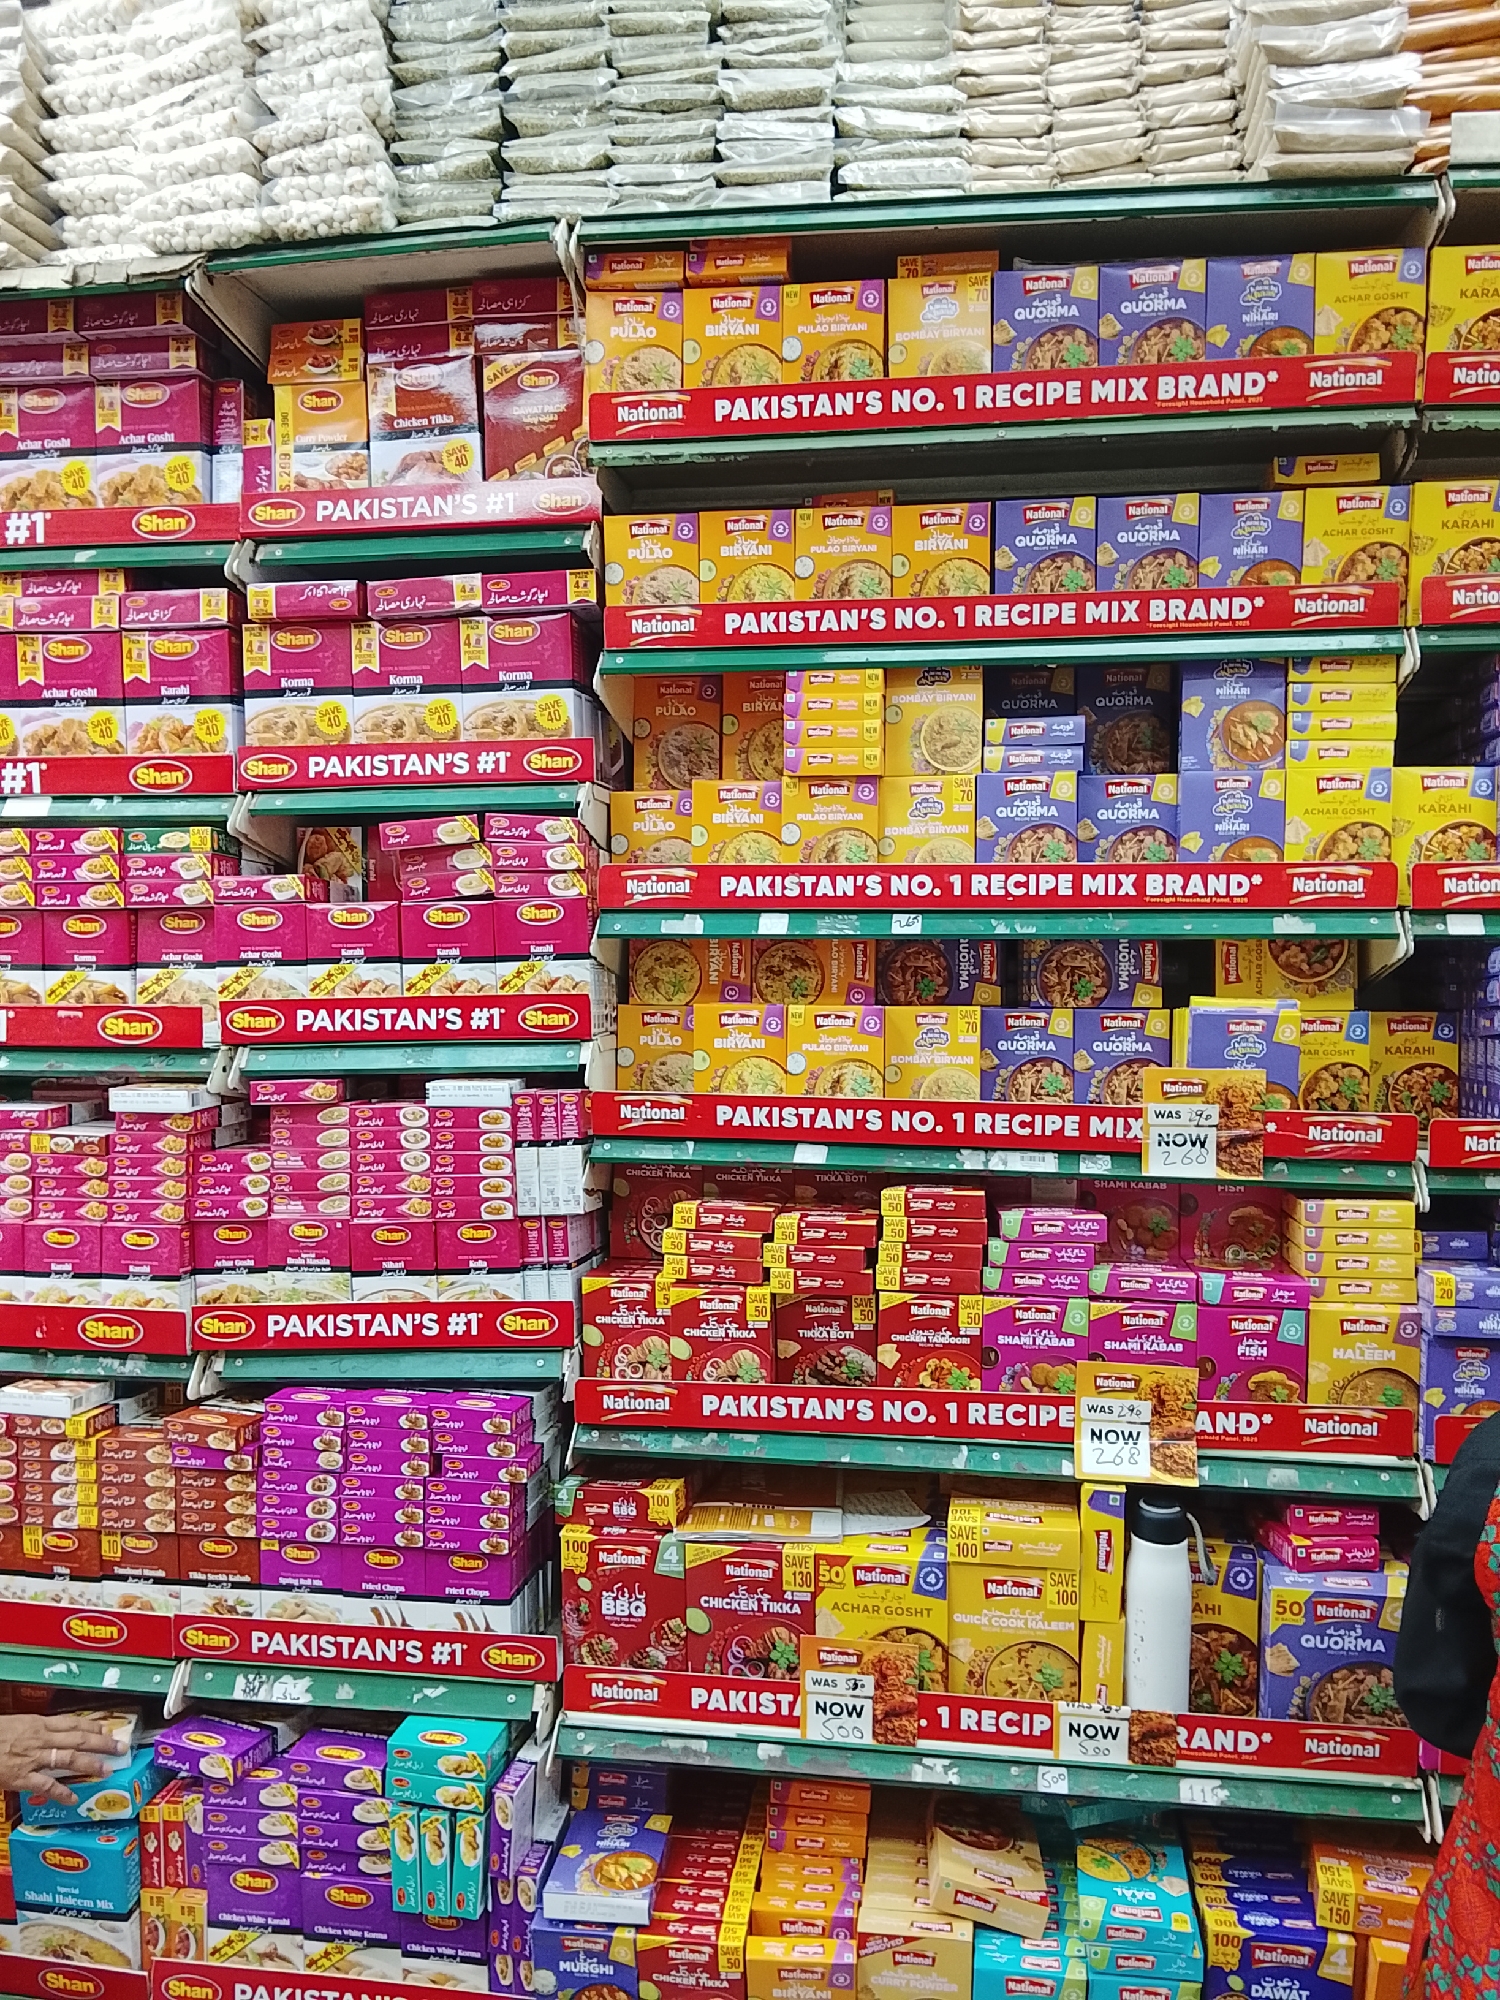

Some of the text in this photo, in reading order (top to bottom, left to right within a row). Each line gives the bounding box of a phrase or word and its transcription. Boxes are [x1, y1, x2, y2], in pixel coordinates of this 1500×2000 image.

[968, 277, 989, 287] SAVE
[1334, 291, 1409, 304] ACHAR GOSHT
[614, 301, 653, 313] National
[1014, 305, 1079, 320] QUORMA
[1242, 311, 1279, 323] NIHARI
[610, 326, 657, 338] PULAO
[705, 323, 760, 336] BIRYANI
[797, 322, 868, 334] PULAO BIRYANI
[895, 327, 985, 341] BOMBAY BIRYANI
[126, 386, 164, 404] Shan
[303, 393, 338, 410] Shan
[617, 405, 685, 422] National
[715, 390, 882, 422] PAKISTAN'S
[891, 388, 944, 412] NO.
[953, 387, 966, 409] 1
[975, 381, 1081, 408] RECIPE
[1091, 377, 1149, 400] MIX
[1309, 369, 1383, 388] National
[393, 414, 454, 427] Chicken Tikka
[118, 432, 175, 444] Achar Gosht
[165, 462, 189, 476] SAVE
[254, 502, 300, 522] Shan
[316, 495, 478, 522] PAKISTAN'S
[539, 491, 583, 510] Shan
[139, 511, 189, 532] Shan
[1441, 518, 1495, 530] KARAHI
[631, 618, 696, 633] National
[724, 606, 886, 634] PAKISTAN'S
[895, 604, 946, 629] NO.
[954, 604, 966, 627] 1
[975, 602, 1076, 626] RECIPE
[1085, 600, 1139, 623] MIX
[1294, 597, 1366, 613] National
[276, 631, 315, 648] Shan
[281, 676, 314, 687] Korma
[316, 706, 343, 718] SAVE
[244, 759, 290, 779] Shan
[307, 753, 468, 779] PAKISTAN'S
[528, 751, 575, 771] Shan
[135, 766, 185, 787] Shan
[1096, 807, 1159, 821] QUORMA
[1417, 802, 1472, 814] KARAHI
[1214, 822, 1250, 832] NIHARI
[626, 877, 691, 895] National
[720, 874, 882, 897] PAKISTAN'S
[892, 874, 941, 896] NO.
[949, 875, 960, 896] 1
[972, 875, 1072, 896] RECIPE
[1082, 874, 1137, 895] MIX
[1292, 876, 1364, 892] National
[104, 1017, 155, 1036] Shan
[232, 1011, 277, 1030] Shan
[297, 1007, 462, 1032] PAKISTAN'S
[524, 1009, 570, 1027] Shan
[620, 1104, 1144, 1139] National PAKISTAN'S NO. 1 RECIPE MIX
[1153, 1110, 1182, 1120] WAS
[1157, 1133, 1208, 1149] NOW
[1308, 1126, 1383, 1143] National
[1435, 1277, 1452, 1288] SAVE
[749, 1292, 768, 1304] SAVE
[84, 1321, 135, 1340] Shan
[200, 1317, 248, 1336] Shan
[267, 1314, 438, 1337] PAKISTAN'S
[501, 1314, 550, 1333] Shan
[683, 1328, 757, 1338] CHICKEN TIKKA
[798, 1330, 854, 1340] TIKKA BOTI
[891, 1334, 970, 1345] CHICKEN TANDOORI
[1103, 1341, 1183, 1353] SHAMI KABAB
[1237, 1345, 1267, 1358] FISH
[1333, 1349, 1396, 1361] HALEEM
[602, 1395, 1074, 1427] National PAKISTAN'S NO. 1 RECIPE
[1086, 1404, 1114, 1415] WAS
[1304, 1418, 1378, 1437] National
[1089, 1428, 1141, 1445] NOW
[599, 1551, 646, 1565] National
[785, 1555, 810, 1570] SAVE
[601, 1600, 647, 1618] BBQ
[700, 1597, 801, 1615] CHICKEN TIKKA
[831, 1602, 932, 1618] ACHAR GOSHT
[68, 1618, 119, 1640] Shan
[953, 1613, 1075, 1631] QUICK COOK HALEEM
[186, 1629, 233, 1648] Shan
[250, 1632, 424, 1663] PAKISTAN'S
[487, 1647, 537, 1667] Shan
[1300, 1633, 1385, 1652] QUORMA
[811, 1677, 838, 1689] WAS
[591, 1683, 658, 1700] National
[815, 1704, 864, 1718] NOW
[1068, 1724, 1119, 1740] NOW
[1305, 1739, 1379, 1757] National
[24, 1890, 115, 1911] Shahi Haleem Mix
[1321, 1891, 1350, 1906] SAVE
[1254, 1950, 1312, 1967] National
[559, 1961, 614, 1975] MURGHI
[45, 1972, 94, 1993] Shan
[168, 1978, 214, 1998] Shan
